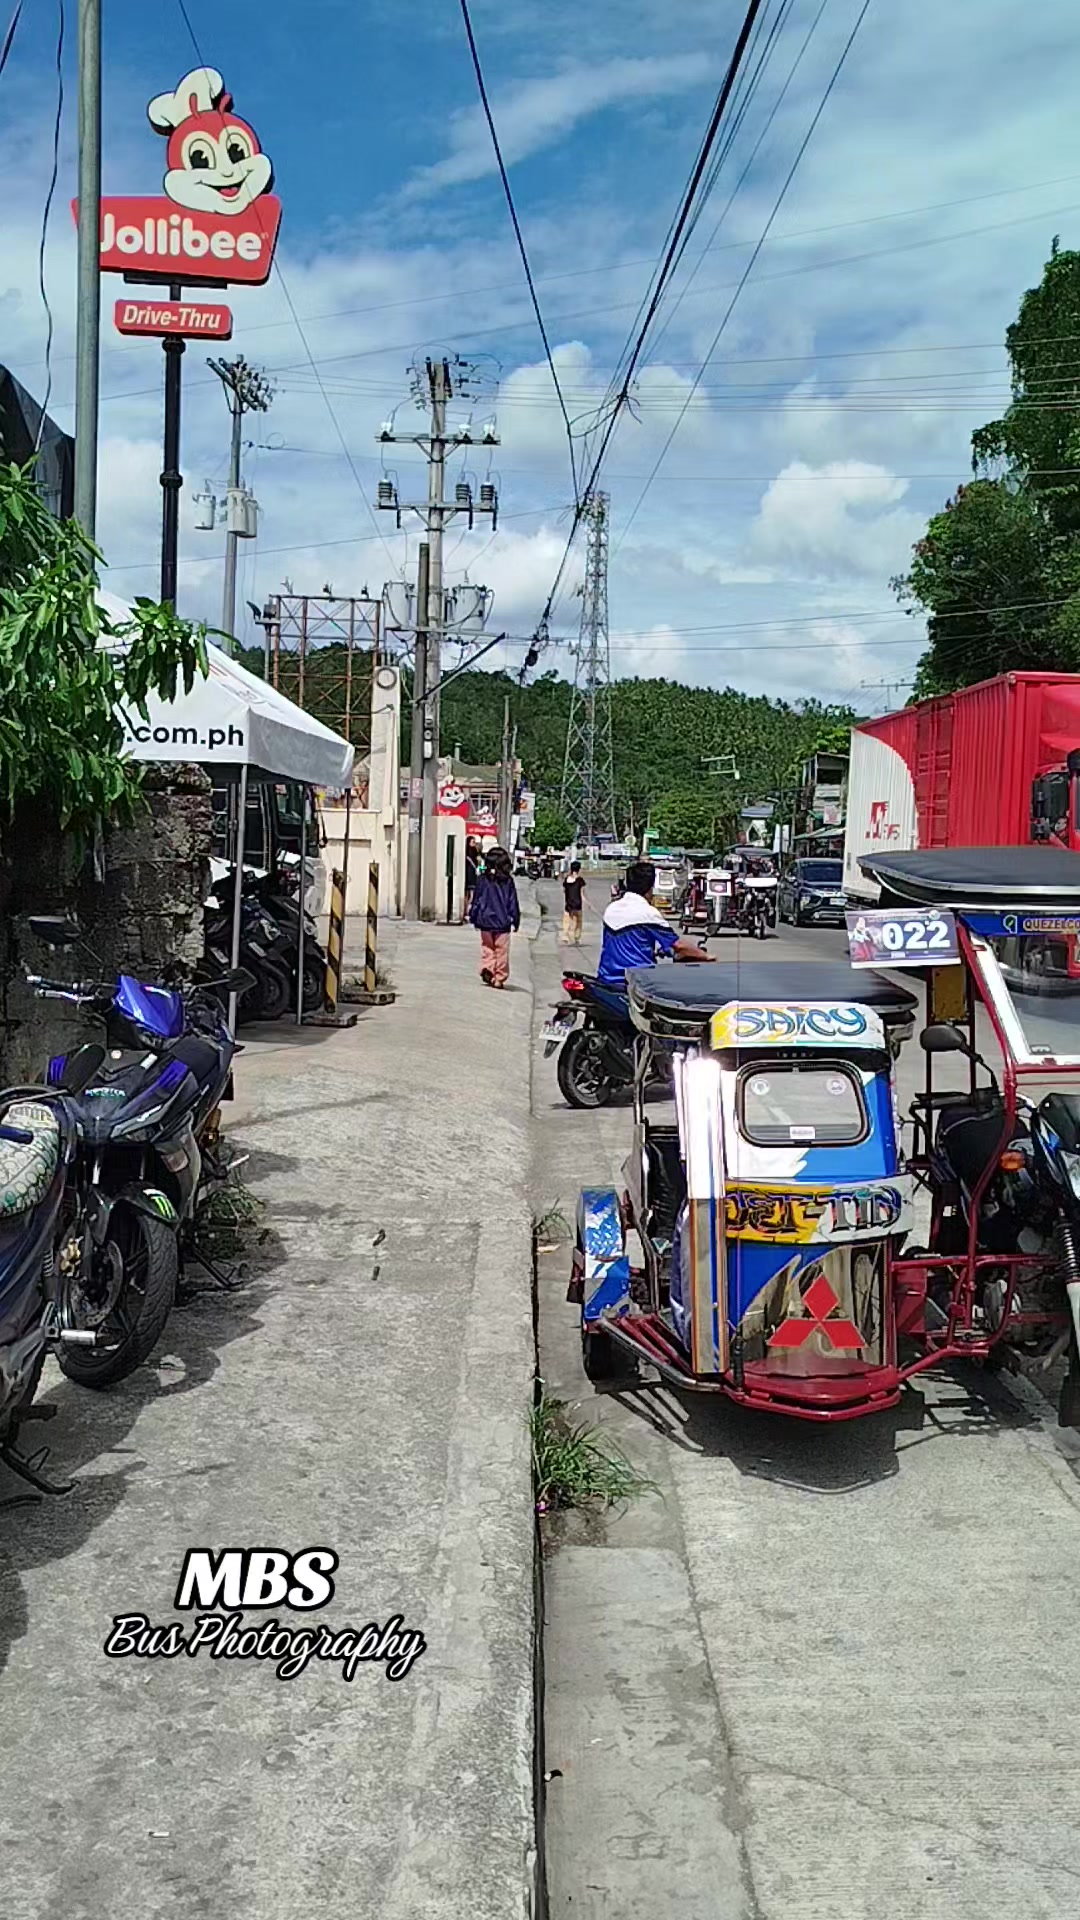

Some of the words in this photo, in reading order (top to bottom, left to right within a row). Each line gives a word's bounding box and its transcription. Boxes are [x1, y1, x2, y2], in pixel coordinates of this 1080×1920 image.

[100, 213, 262, 261] Jollibee
[122, 304, 221, 329] Drive-Thru
[123, 724, 244, 750] .com.ph
[882, 920, 951, 951] 022
